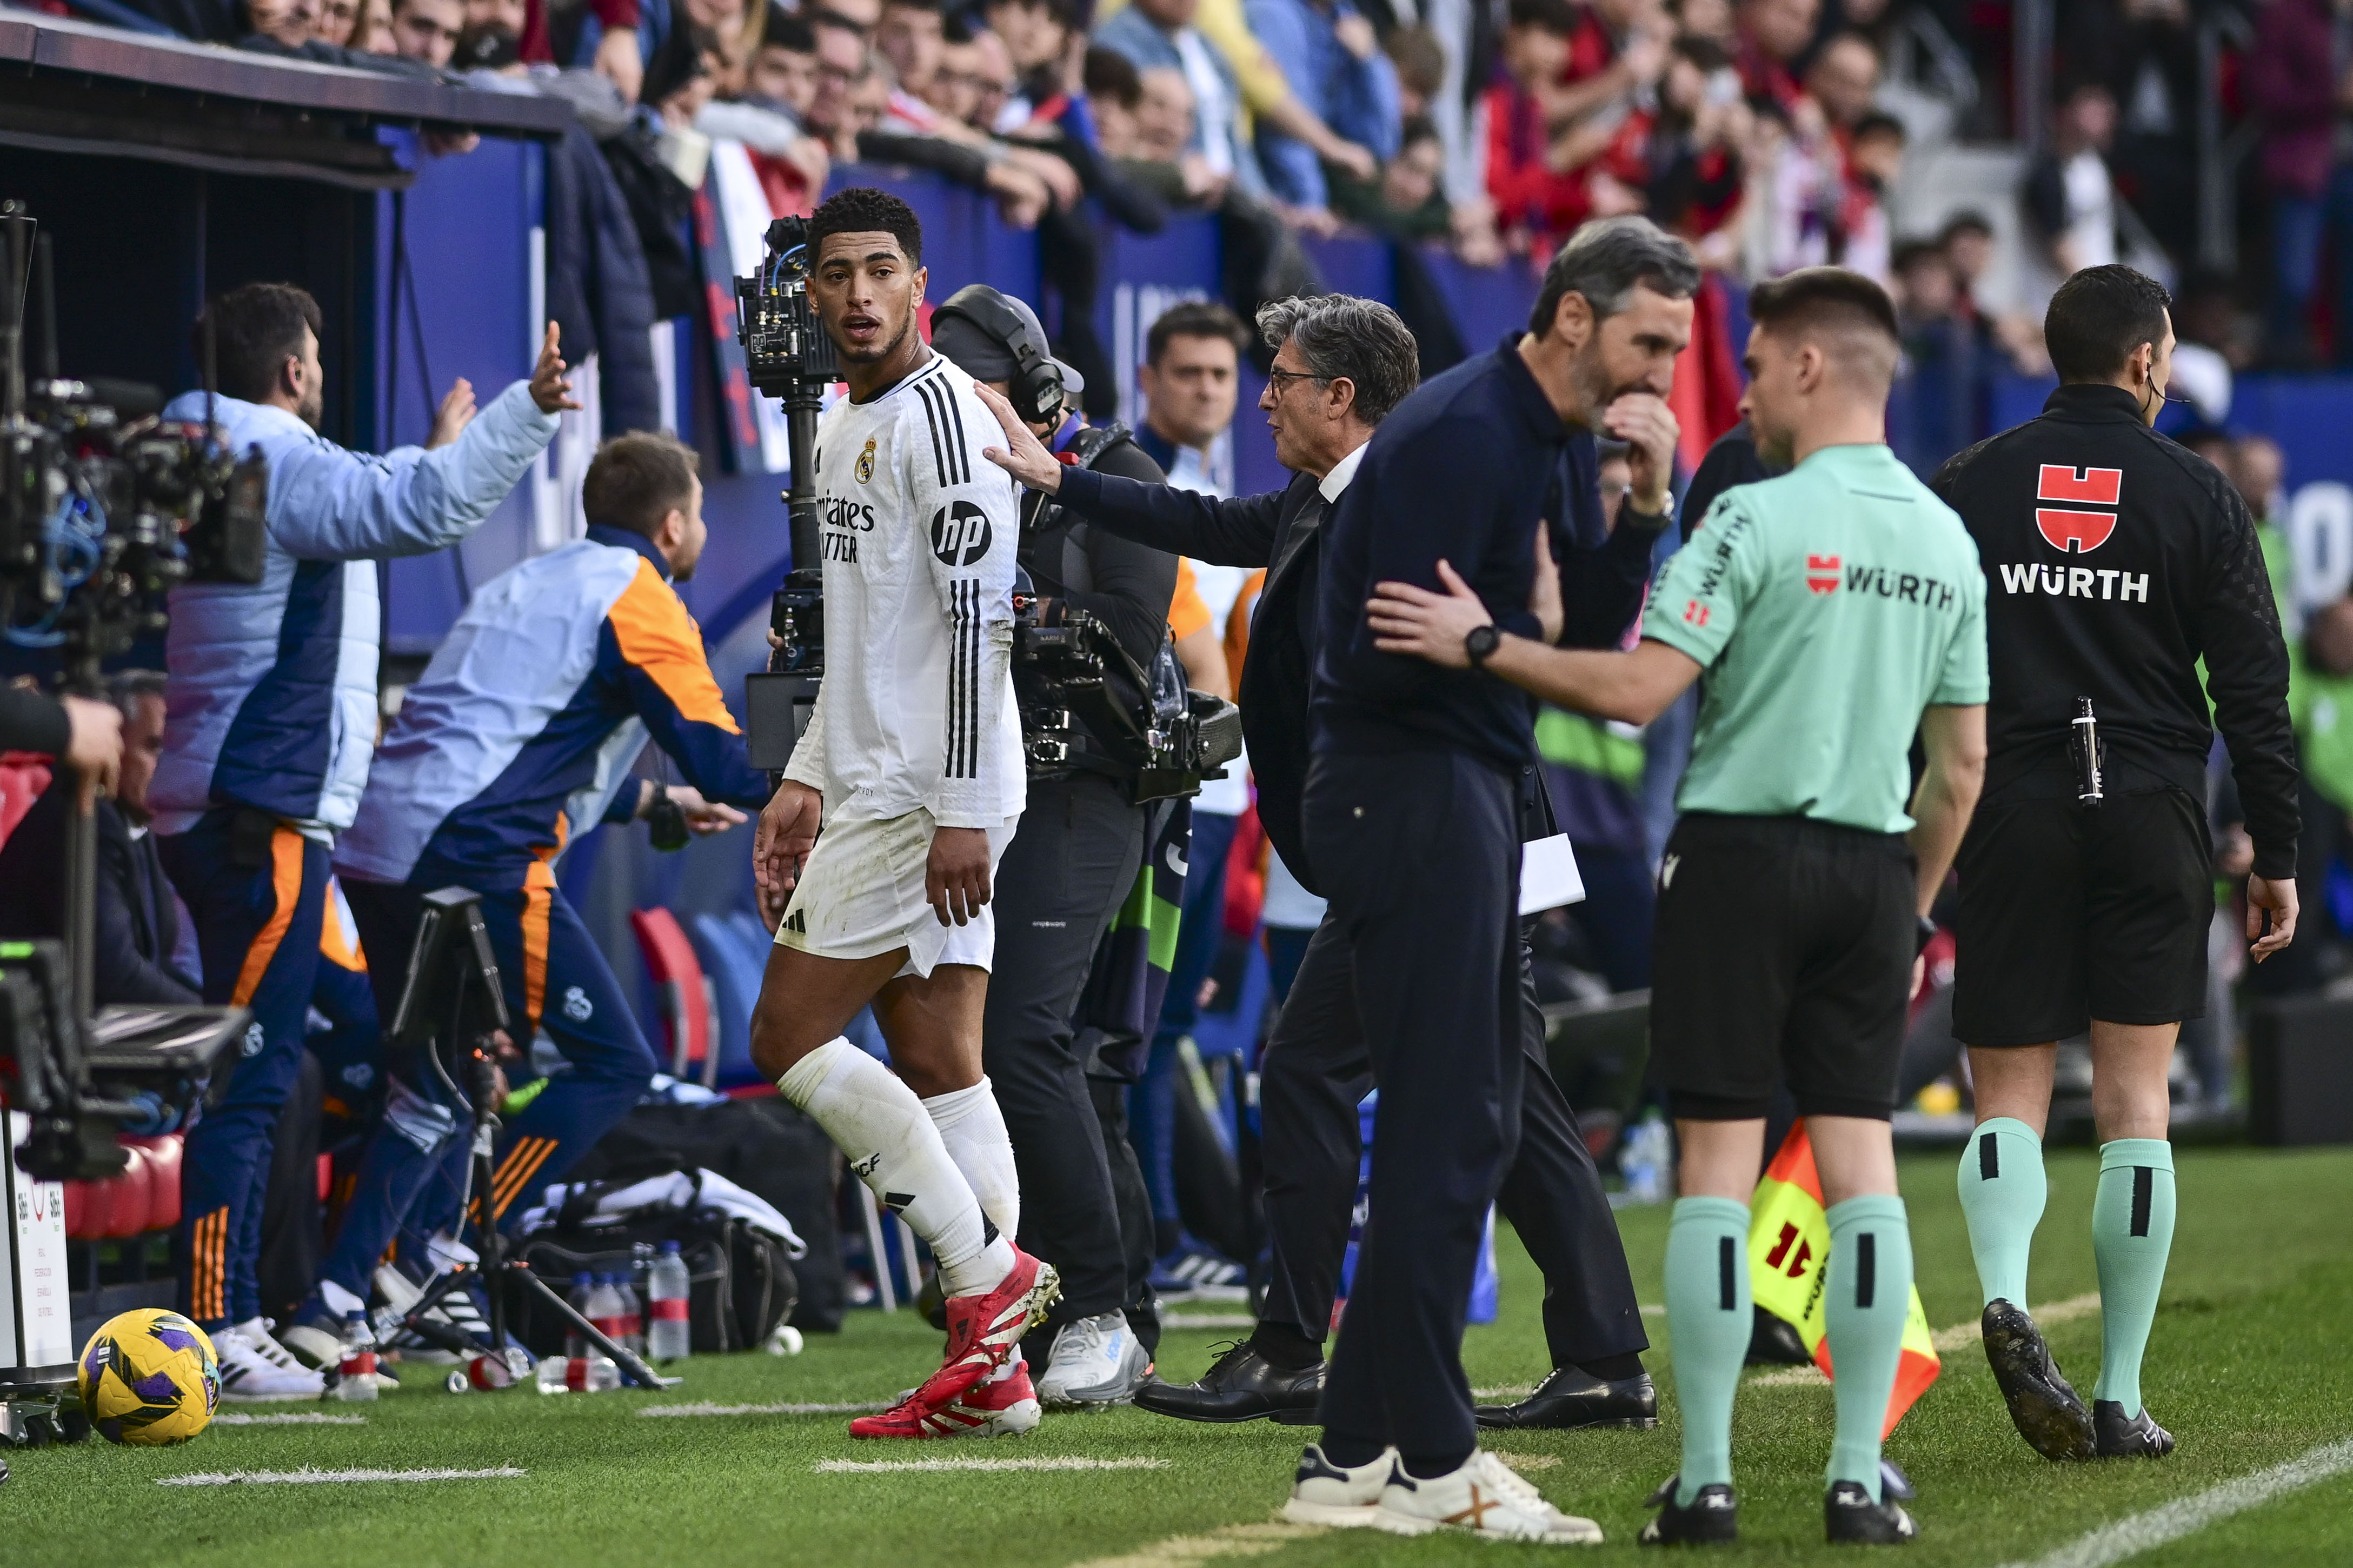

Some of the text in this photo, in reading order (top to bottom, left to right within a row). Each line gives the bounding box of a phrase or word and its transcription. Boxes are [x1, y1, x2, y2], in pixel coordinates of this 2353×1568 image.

[816, 489, 874, 532] mirates
[934, 501, 988, 568] hp
[1846, 565, 1955, 613] WÜRTH
[1999, 563, 2149, 603] WÜRTH
